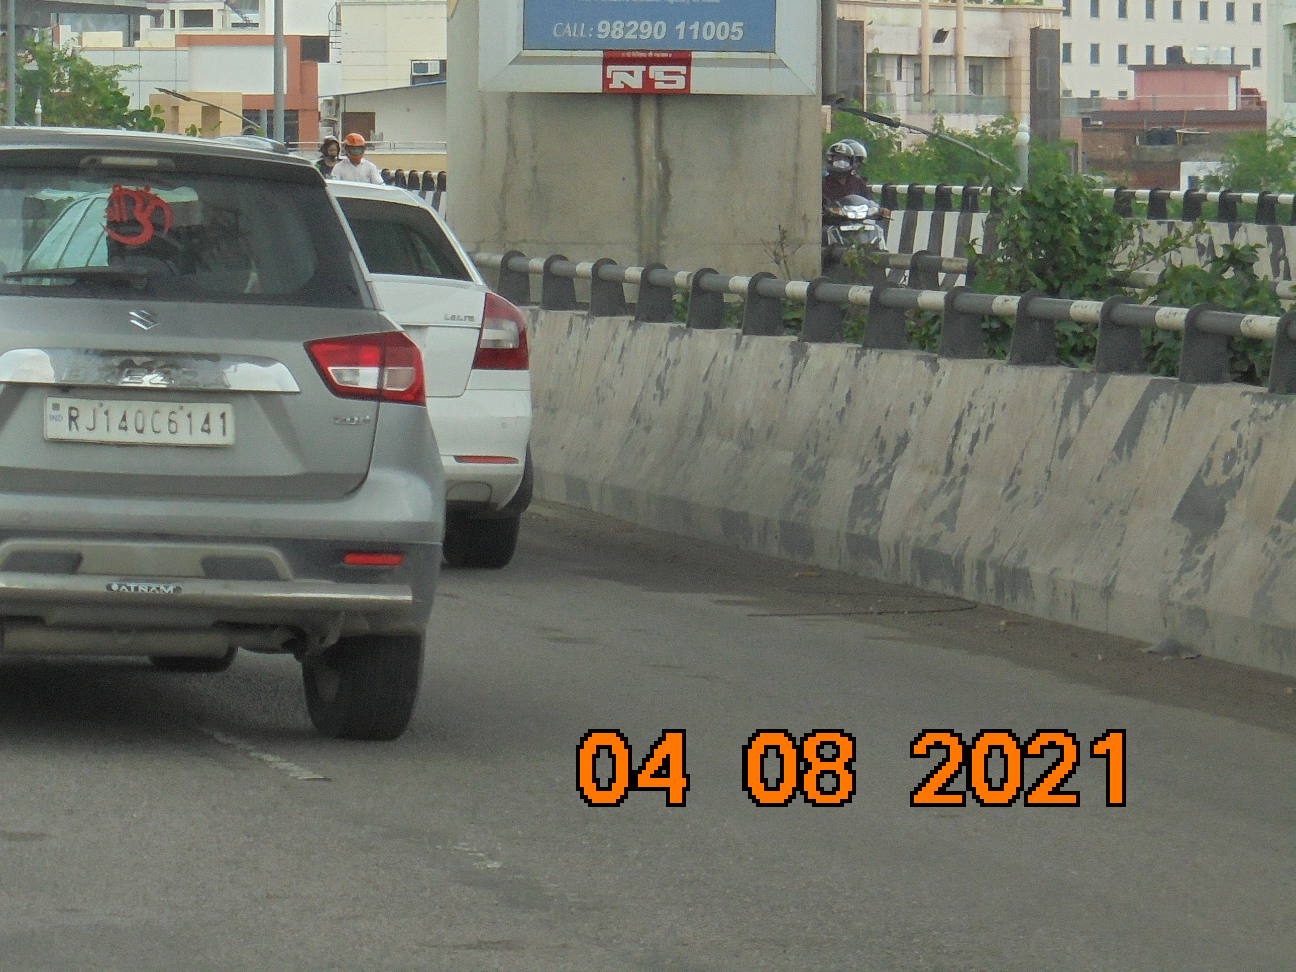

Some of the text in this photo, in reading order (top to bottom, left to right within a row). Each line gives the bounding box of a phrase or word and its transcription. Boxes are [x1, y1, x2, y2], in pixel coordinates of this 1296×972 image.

[597, 21, 667, 41] 98290
[675, 21, 745, 42] 11005
[606, 65, 687, 89] NS
